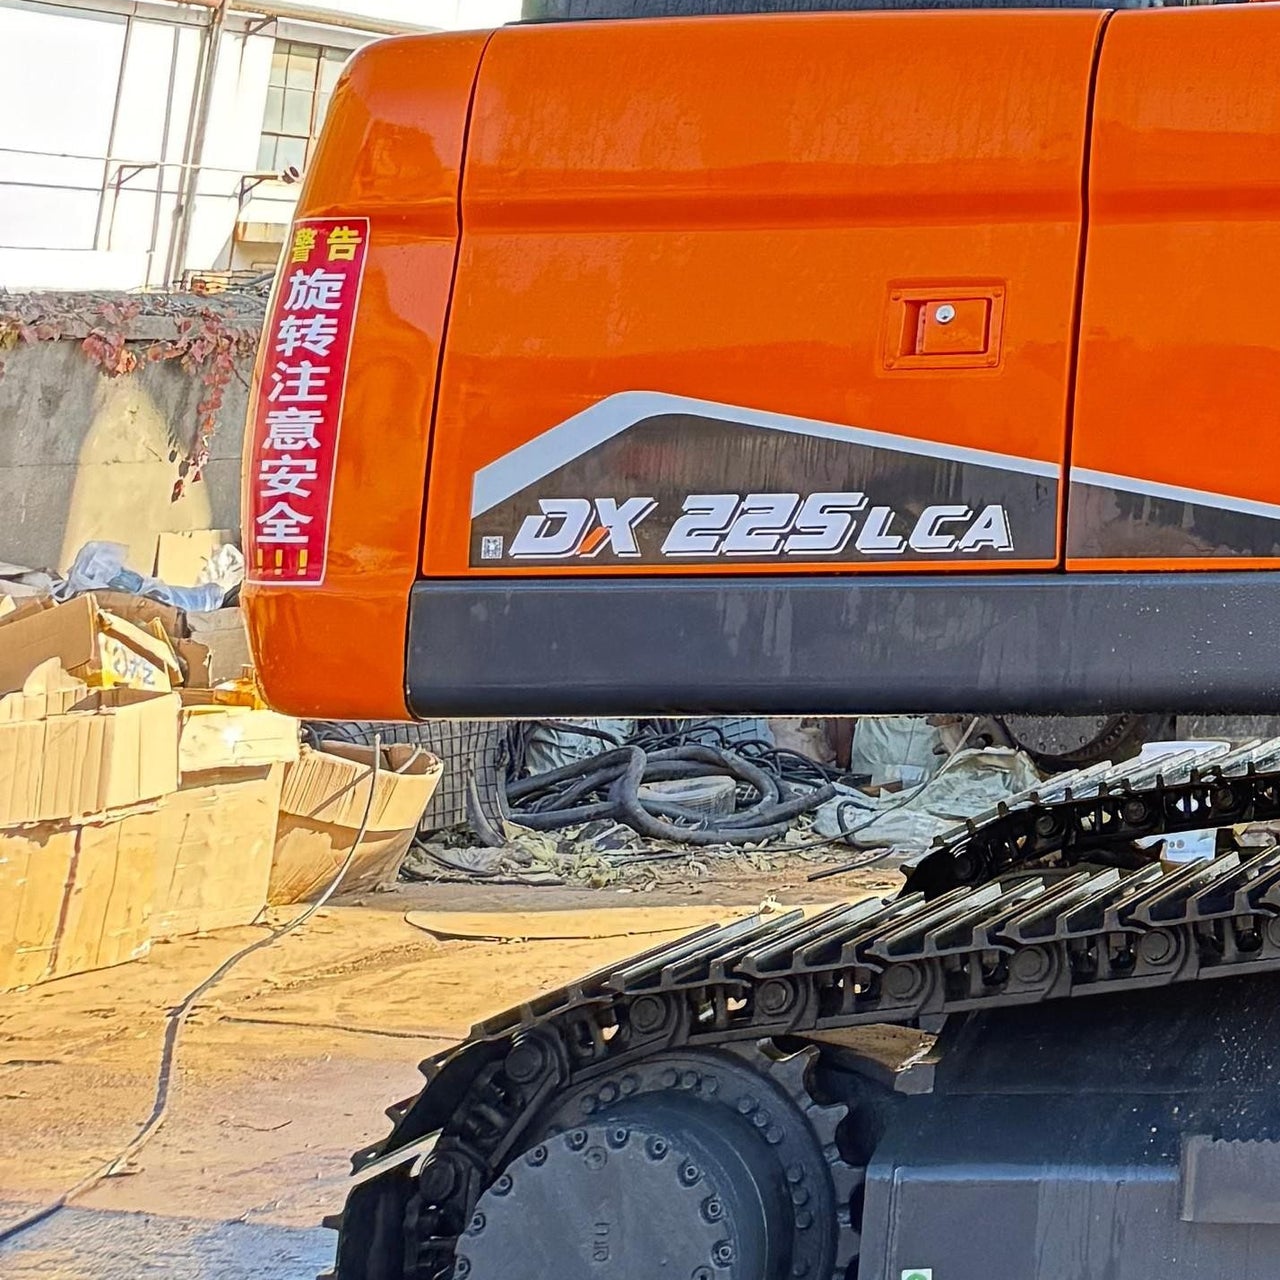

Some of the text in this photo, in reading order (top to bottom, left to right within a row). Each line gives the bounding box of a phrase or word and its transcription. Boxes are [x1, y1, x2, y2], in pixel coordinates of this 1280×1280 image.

[291, 225, 363, 264] 警告
[256, 267, 347, 544] 旋转注意安全
[509, 497, 660, 558] DX
